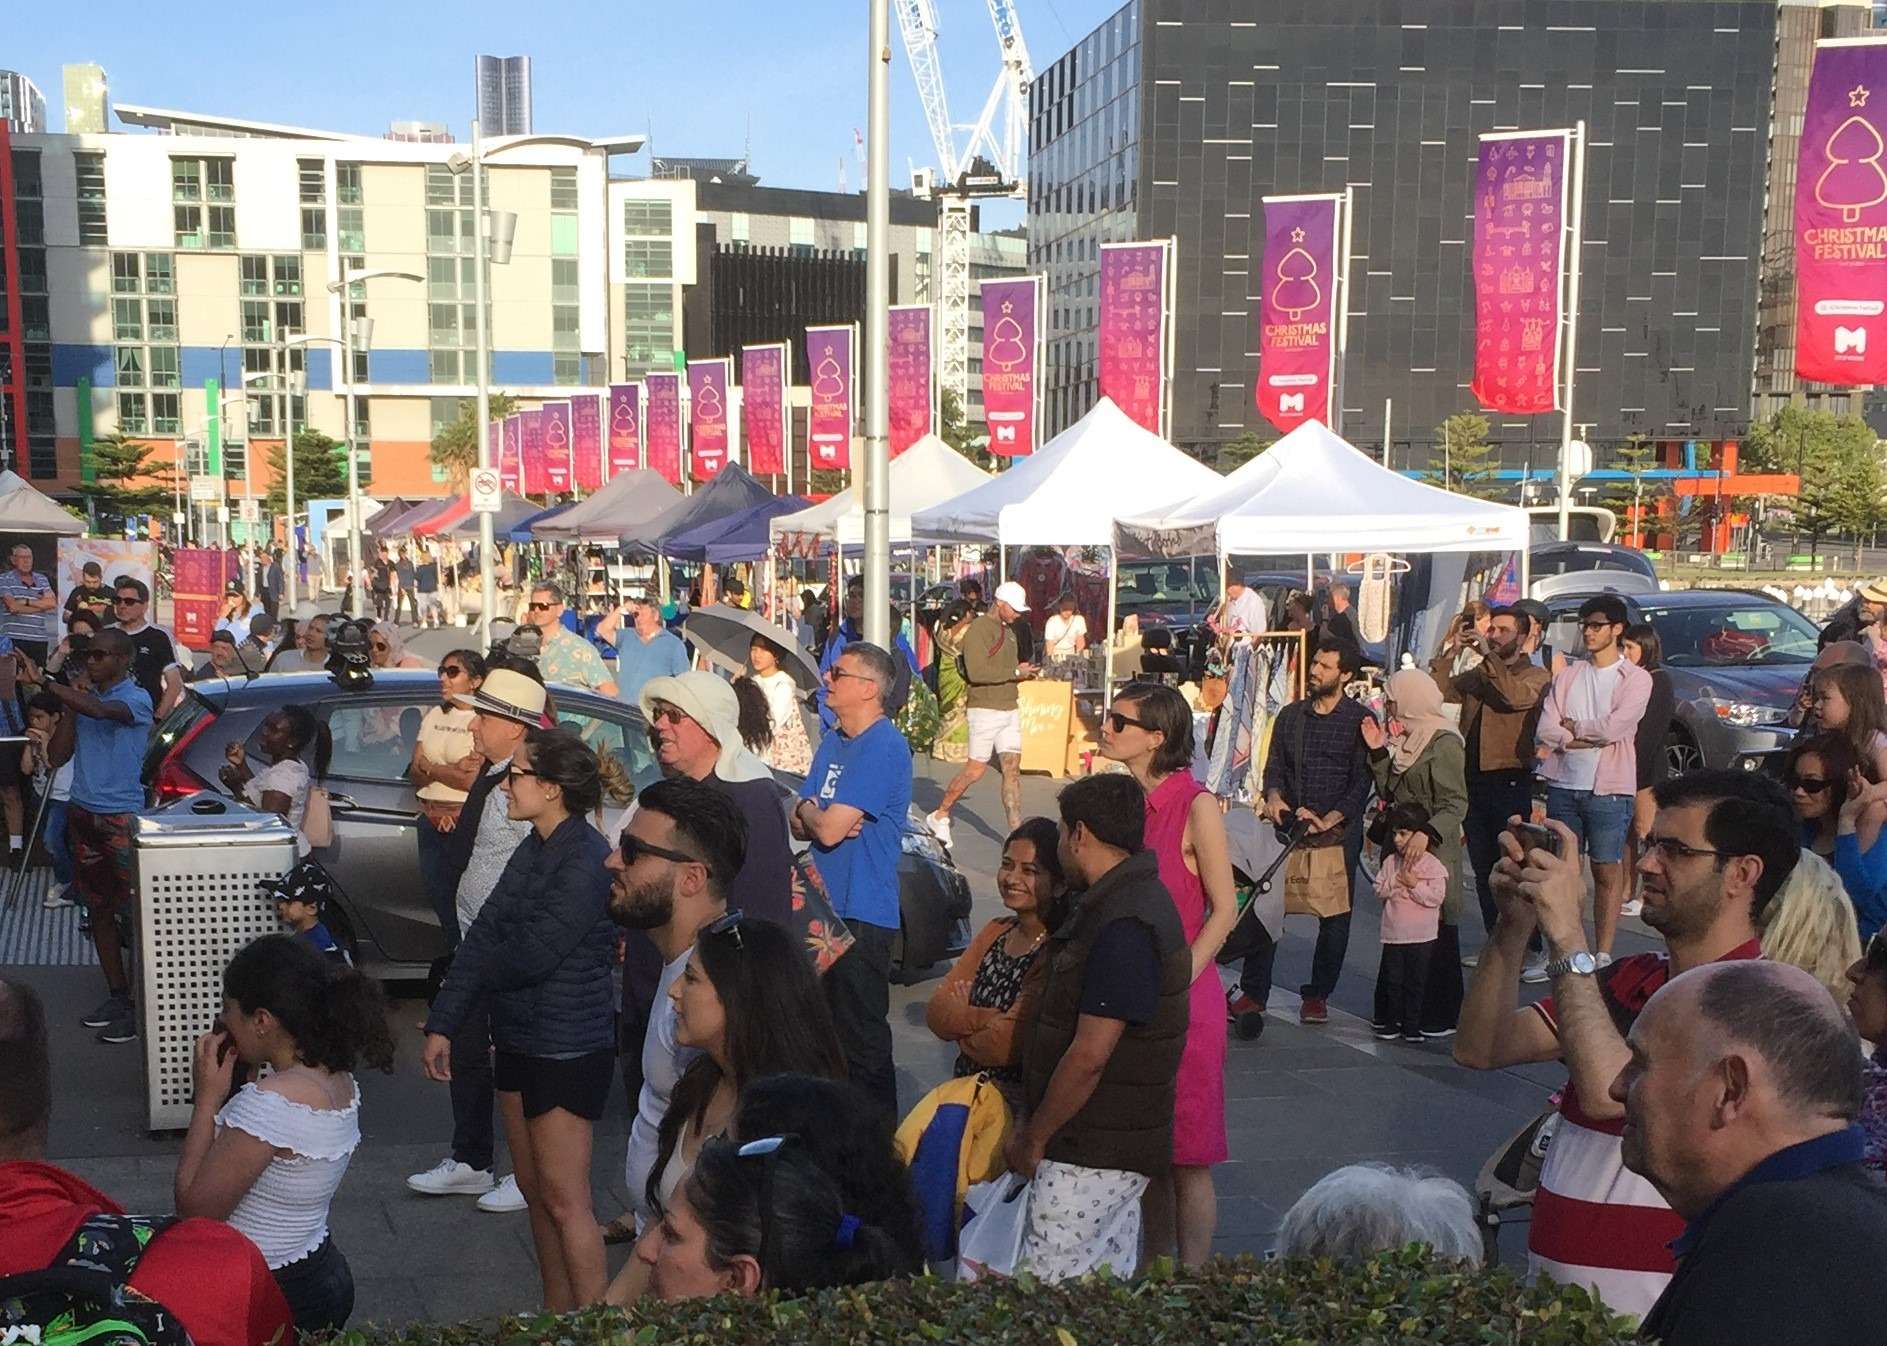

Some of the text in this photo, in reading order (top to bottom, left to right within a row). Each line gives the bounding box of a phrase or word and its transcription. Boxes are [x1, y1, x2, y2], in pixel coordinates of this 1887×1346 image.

[1803, 226, 1887, 245] CHRISTMA
[1813, 243, 1887, 260] FESTIVAL
[1265, 322, 1327, 336] CHRISTMAS
[1270, 334, 1319, 348] FESTIVAL
